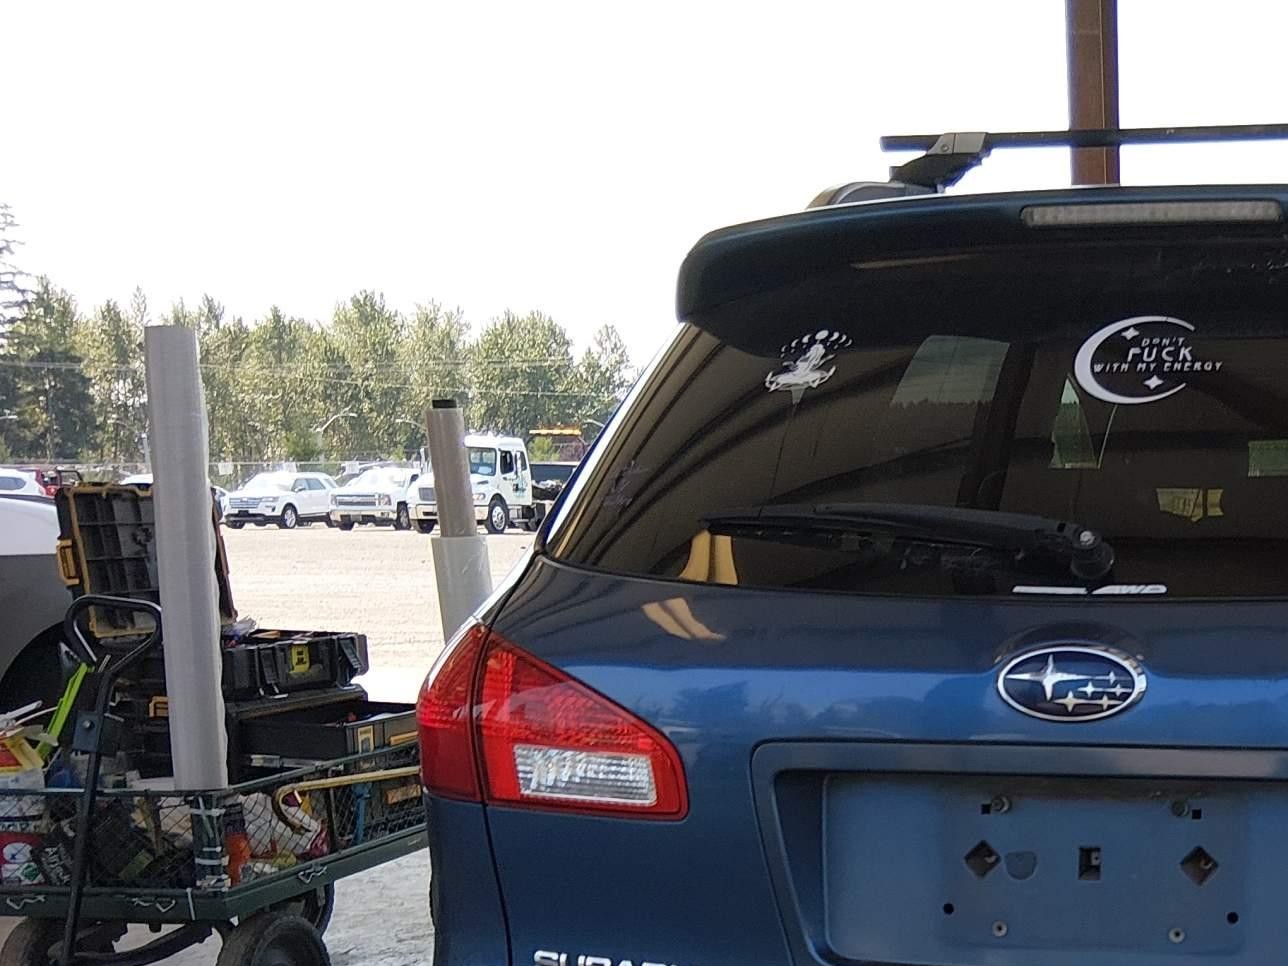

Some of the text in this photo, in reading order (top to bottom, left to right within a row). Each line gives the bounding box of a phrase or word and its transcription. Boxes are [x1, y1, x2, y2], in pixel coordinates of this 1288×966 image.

[1141, 336, 1185, 348] DON'T
[1127, 346, 1193, 362] FUCK
[1093, 360, 1223, 374] WITH MY ENERGY
